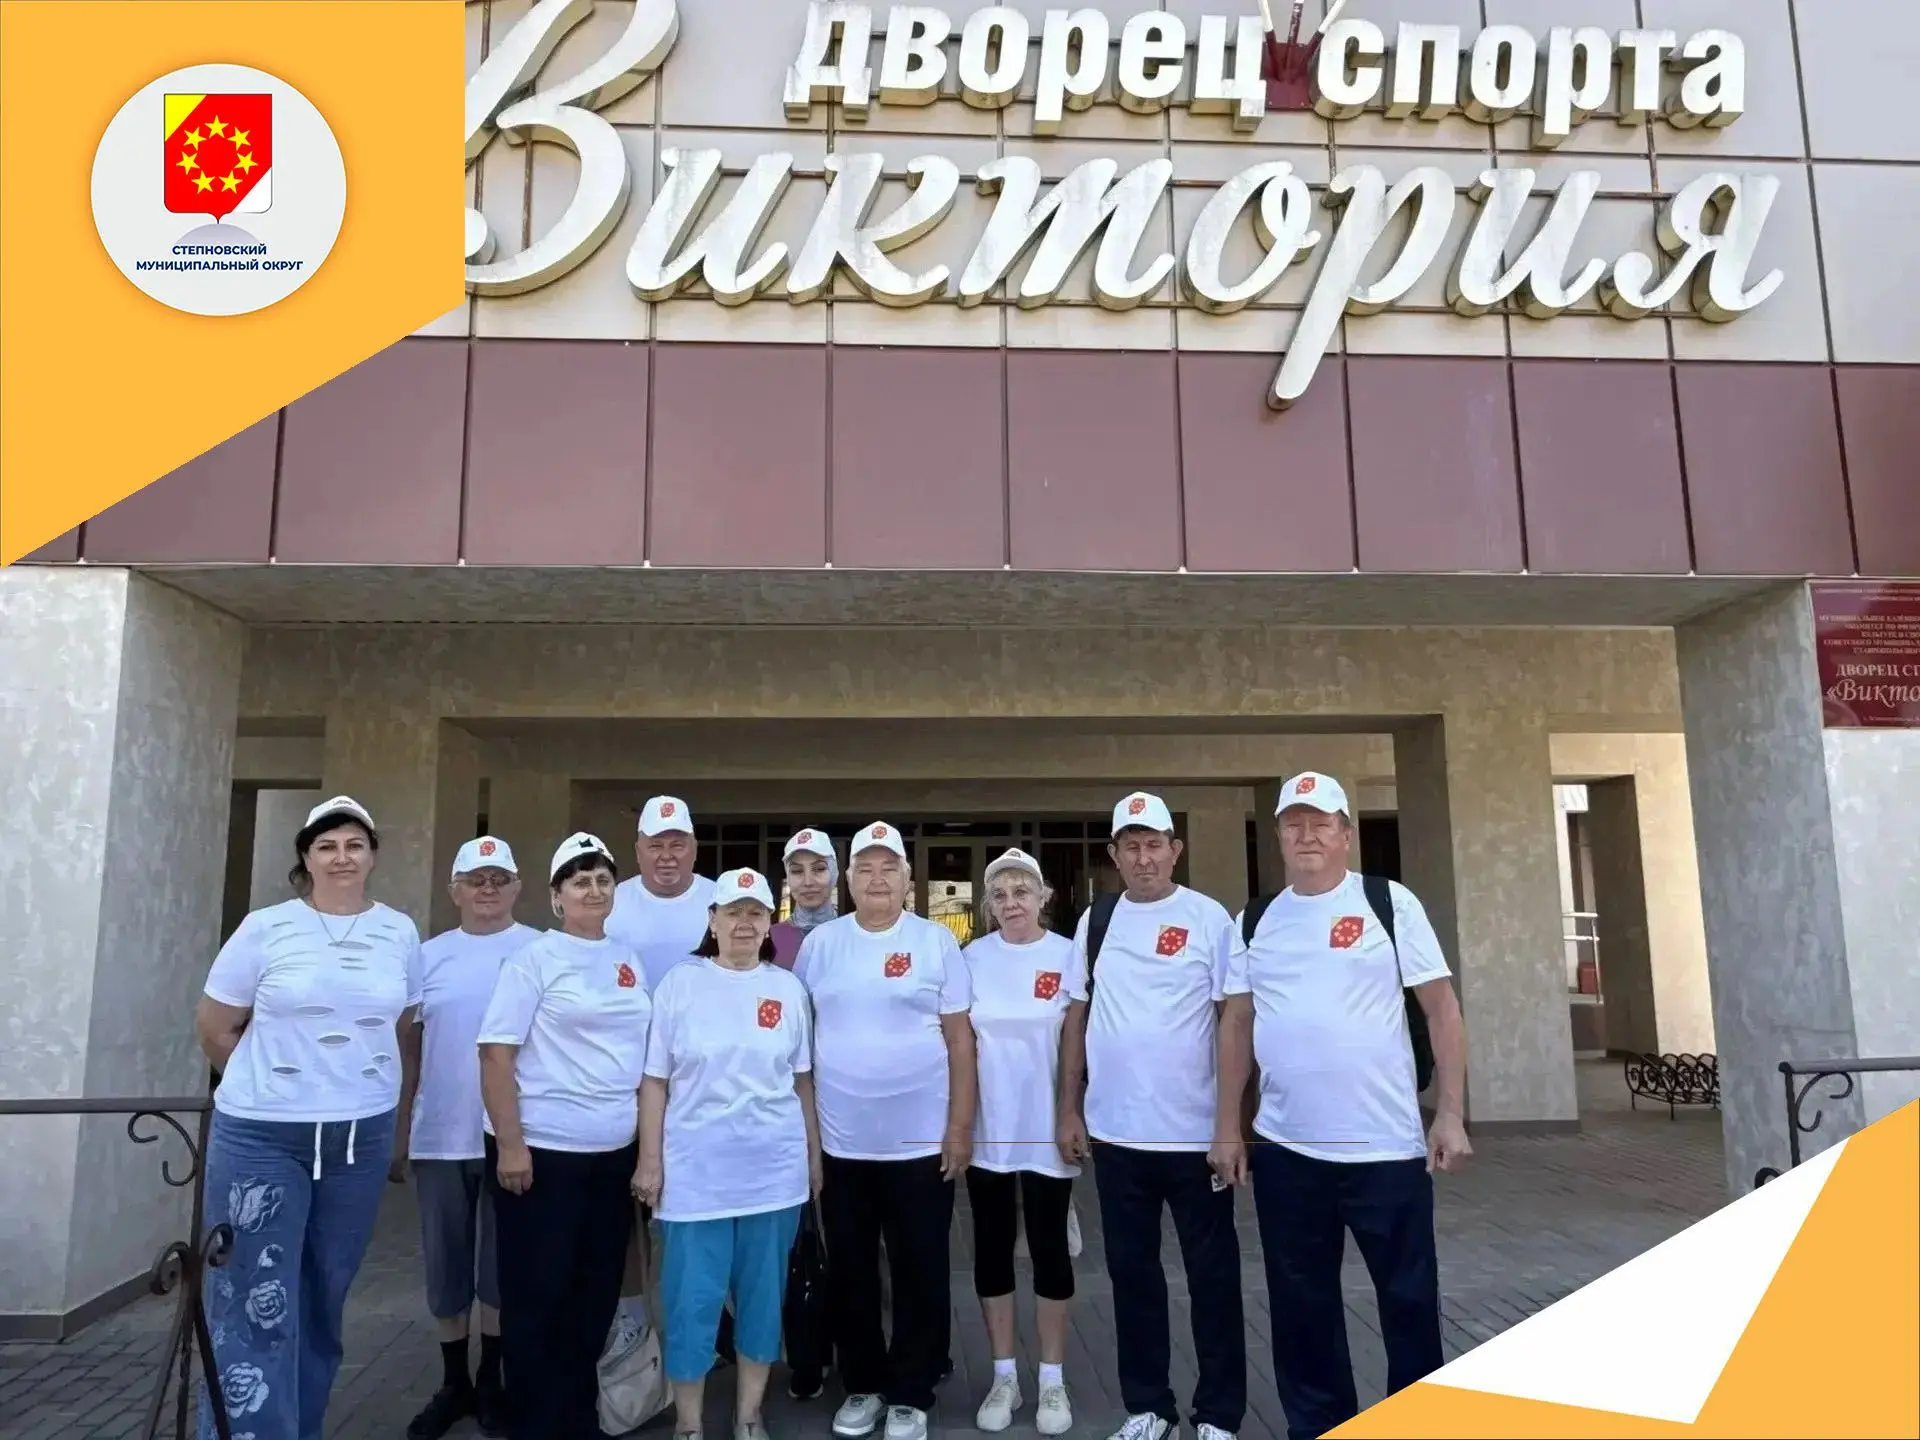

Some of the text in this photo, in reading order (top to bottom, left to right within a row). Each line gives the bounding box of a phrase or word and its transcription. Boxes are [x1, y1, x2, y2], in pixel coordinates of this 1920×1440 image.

[1314, 18, 1746, 148] спорта
[465, 0, 1785, 409] Виктория
[1836, 664, 1899, 677] ДВОРЕЦ
